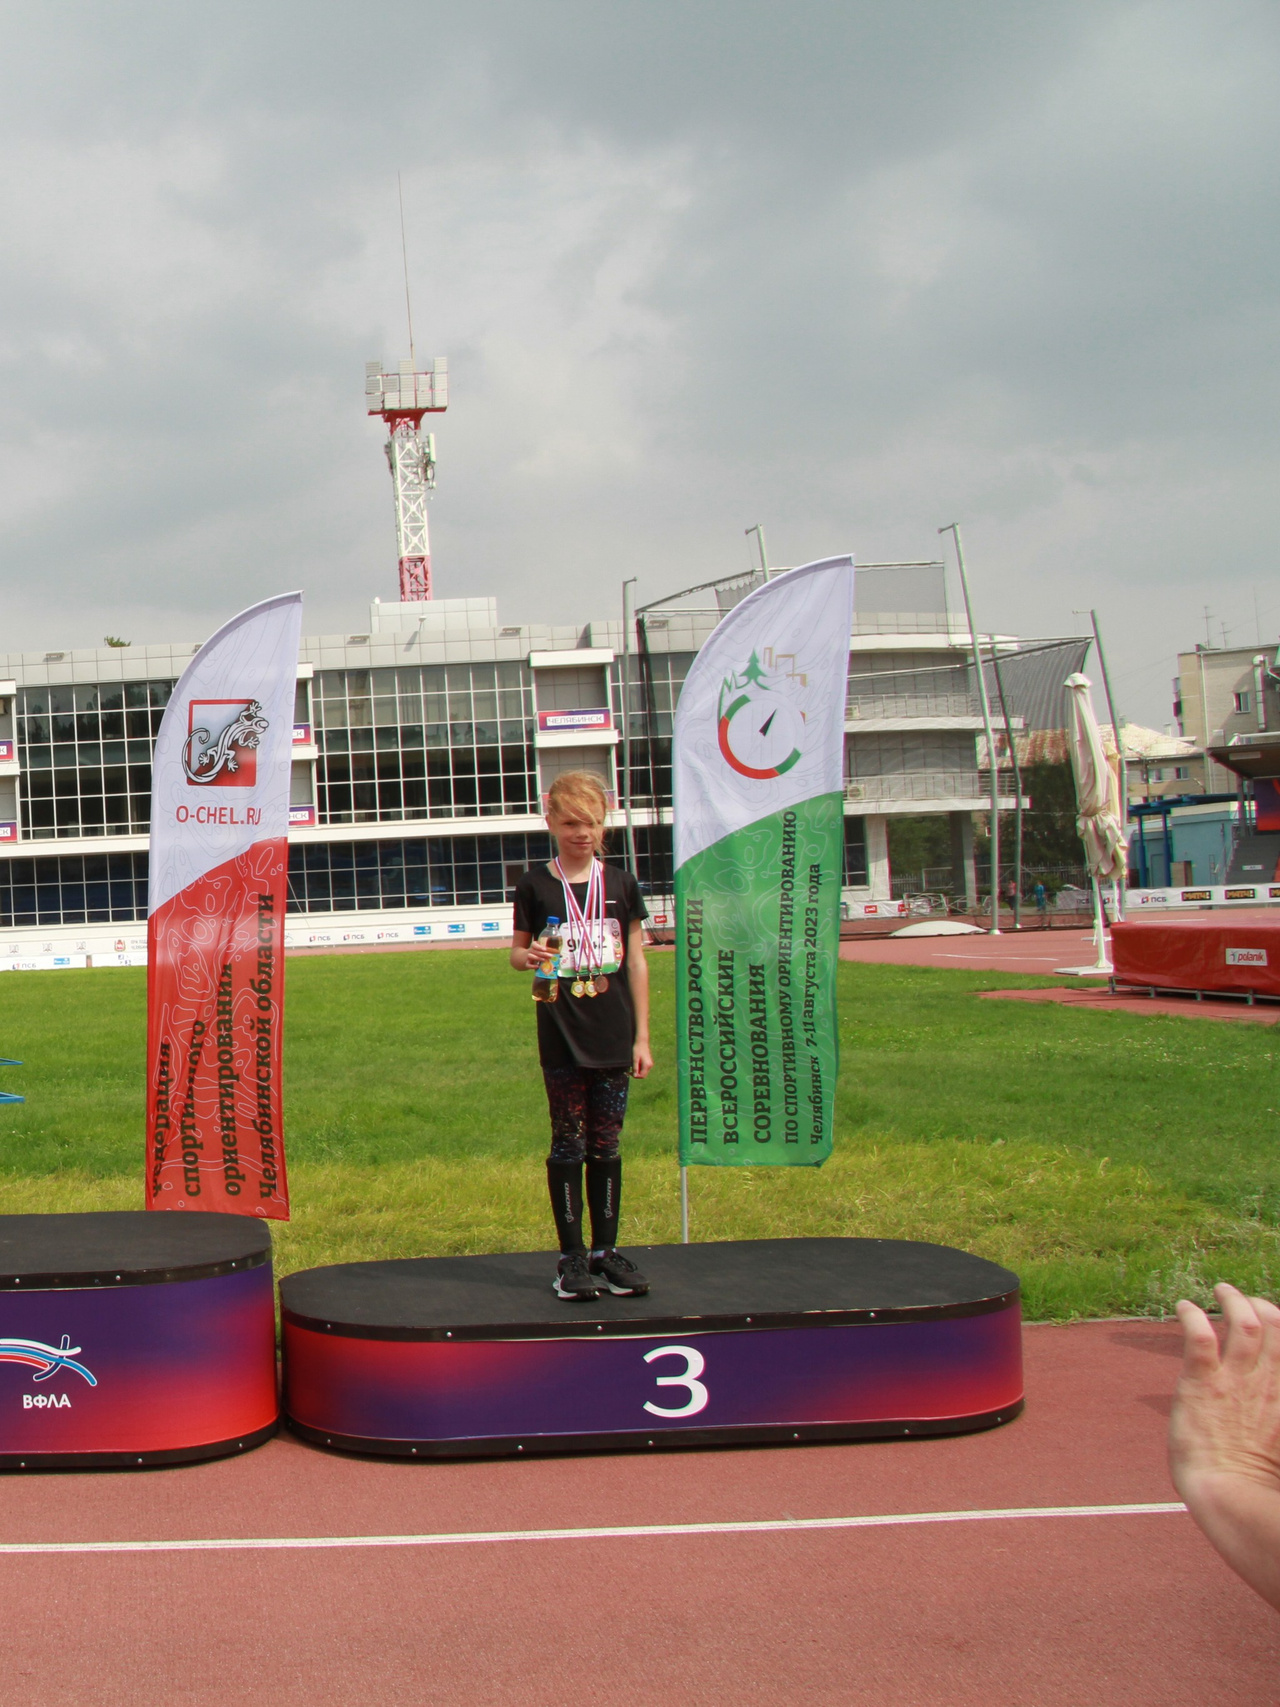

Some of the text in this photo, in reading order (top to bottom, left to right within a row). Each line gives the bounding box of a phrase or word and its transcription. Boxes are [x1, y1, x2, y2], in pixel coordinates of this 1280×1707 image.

[547, 714, 603, 726] ЧЕЛЯБИНСК
[804, 907, 818, 949] 2023
[808, 863, 822, 904] года
[778, 811, 798, 1144] ПО СПОРТИВНОМУ ОРИЕНТИРОВАНИЮ
[1237, 951, 1264, 963] polanik
[249, 894, 277, 1199] Челябинской области
[687, 899, 707, 1144] ПЕРВЕНСТВО РОССИИ
[712, 950, 739, 1144] ВСЕРОССИЙСКИЕ
[749, 963, 771, 1143] СОРЕВНОВАНИЯ
[217, 963, 242, 1196] ориентирования
[808, 1055, 823, 1145] Челябинск
[22, 1393, 72, 1409] ВФЛА
[642, 1345, 708, 1417] 3
